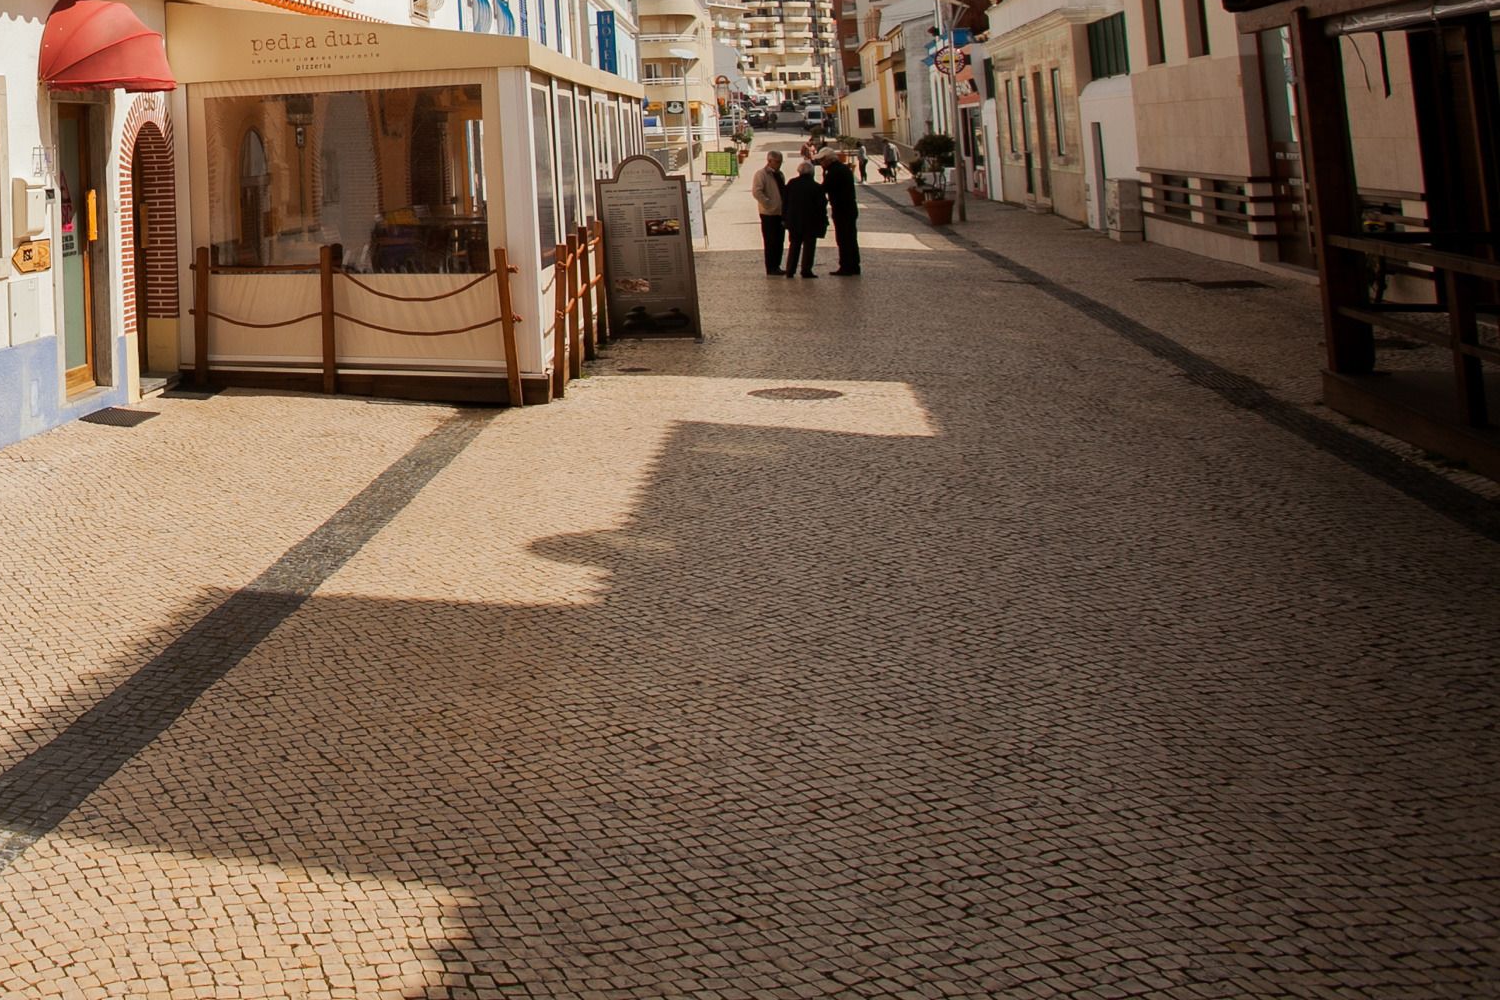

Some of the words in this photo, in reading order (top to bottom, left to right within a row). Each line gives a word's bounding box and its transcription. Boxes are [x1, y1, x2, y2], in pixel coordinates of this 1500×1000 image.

[250, 33, 318, 56] pedra
[324, 30, 380, 48] dura
[296, 63, 332, 71] pizzeria
